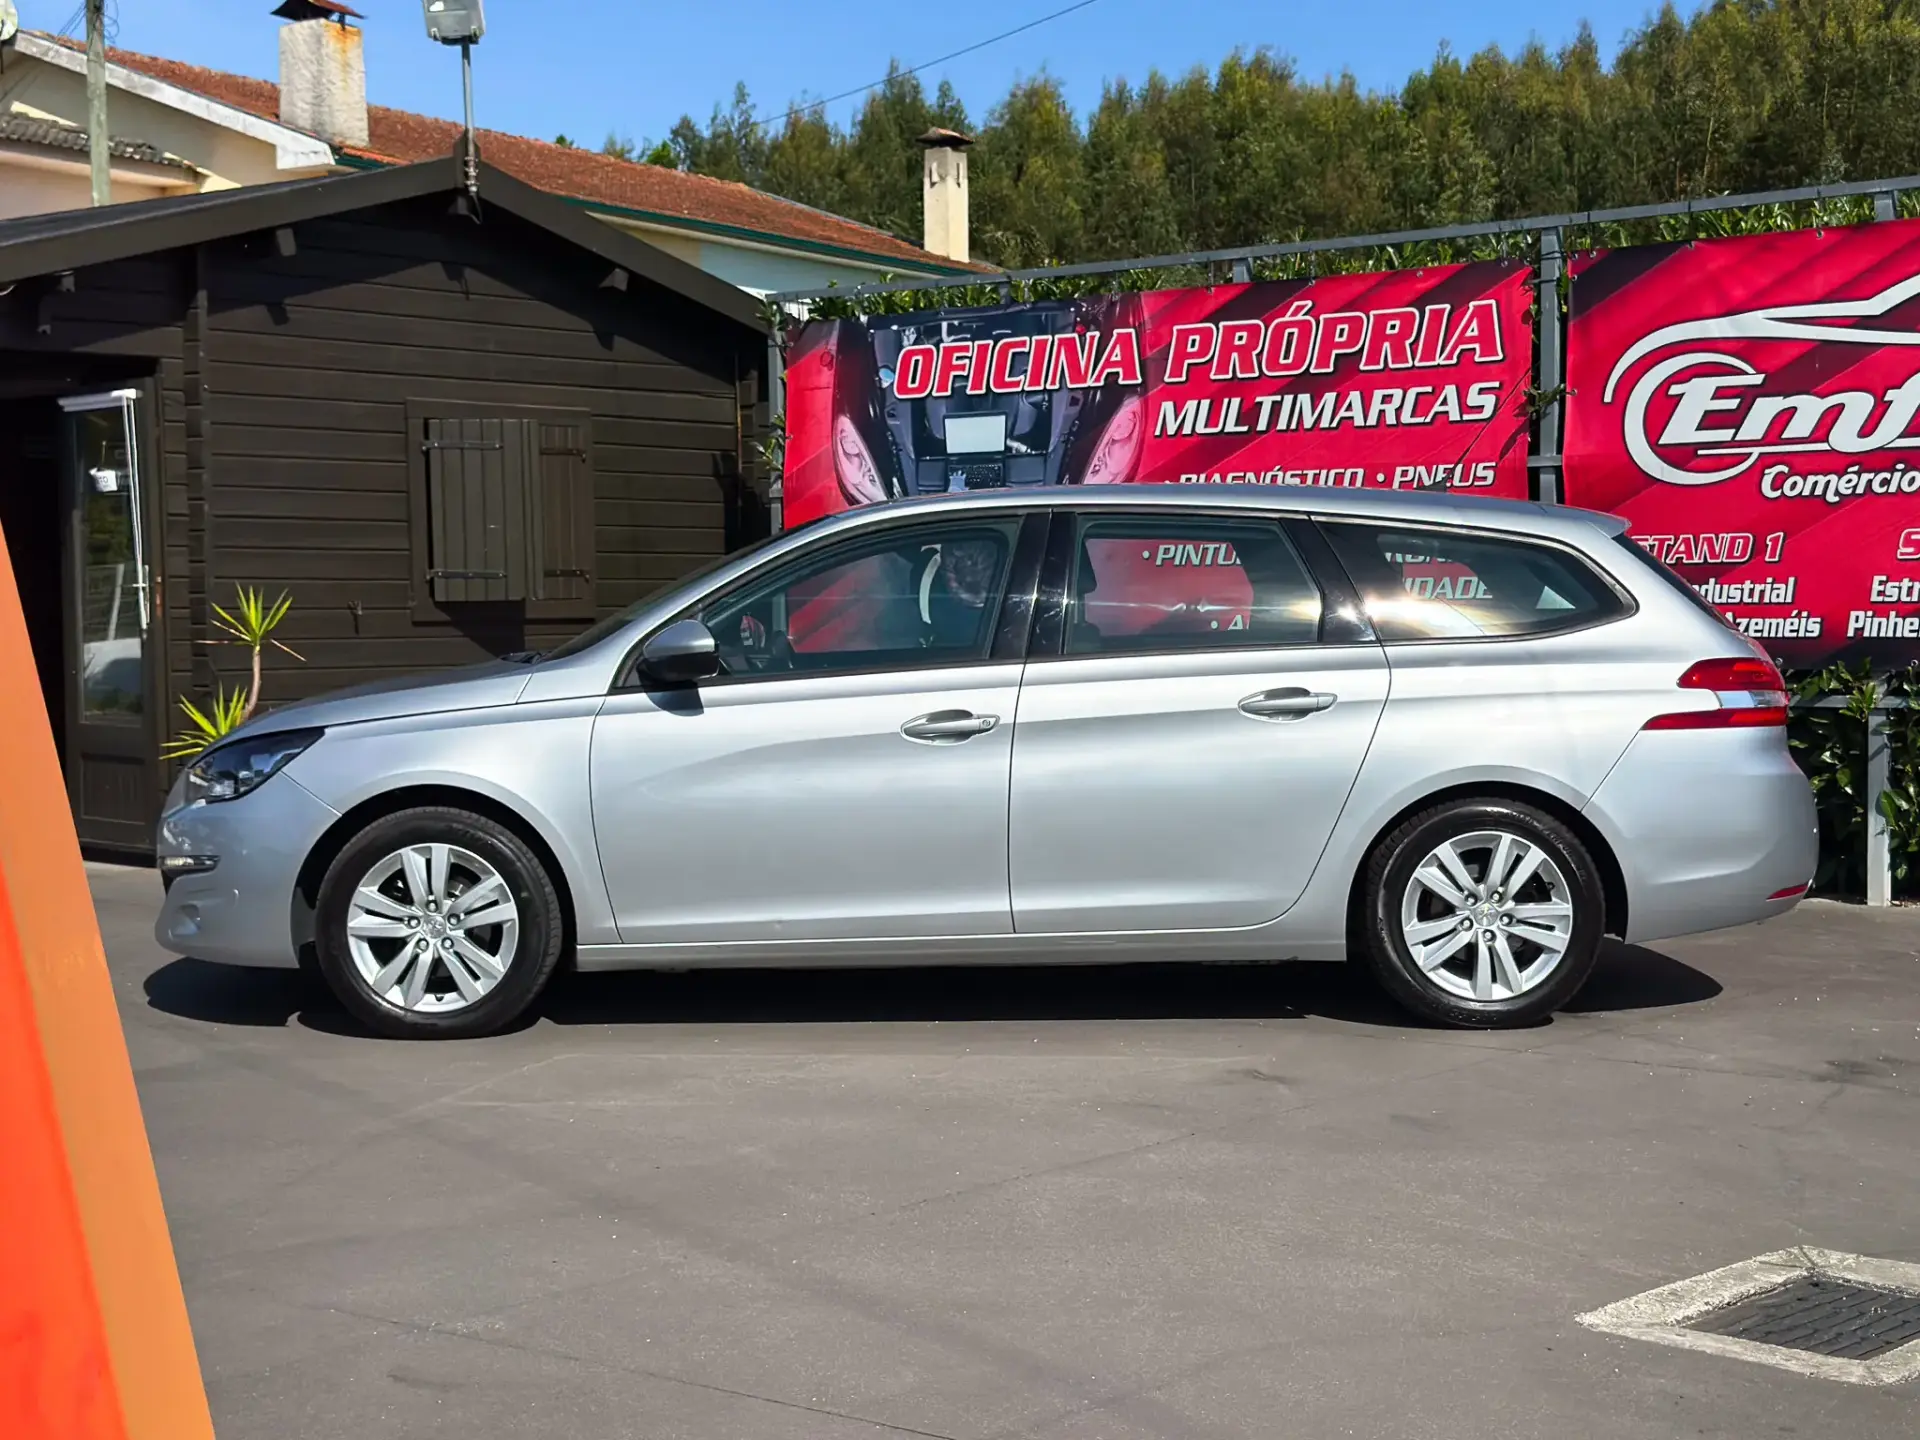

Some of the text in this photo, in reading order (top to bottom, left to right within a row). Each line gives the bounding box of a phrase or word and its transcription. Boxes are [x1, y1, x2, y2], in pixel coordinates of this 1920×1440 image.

[893, 299, 1503, 400] OFICINA PRÓPRIA
[1154, 381, 1500, 436] MULTIMARCAS
[1761, 463, 1920, 503] Comércio
[1156, 544, 1241, 566] PINTU
[1765, 532, 1784, 562] 1
[1692, 577, 1796, 604] dustrial
[1847, 610, 1920, 637] Pinhe
